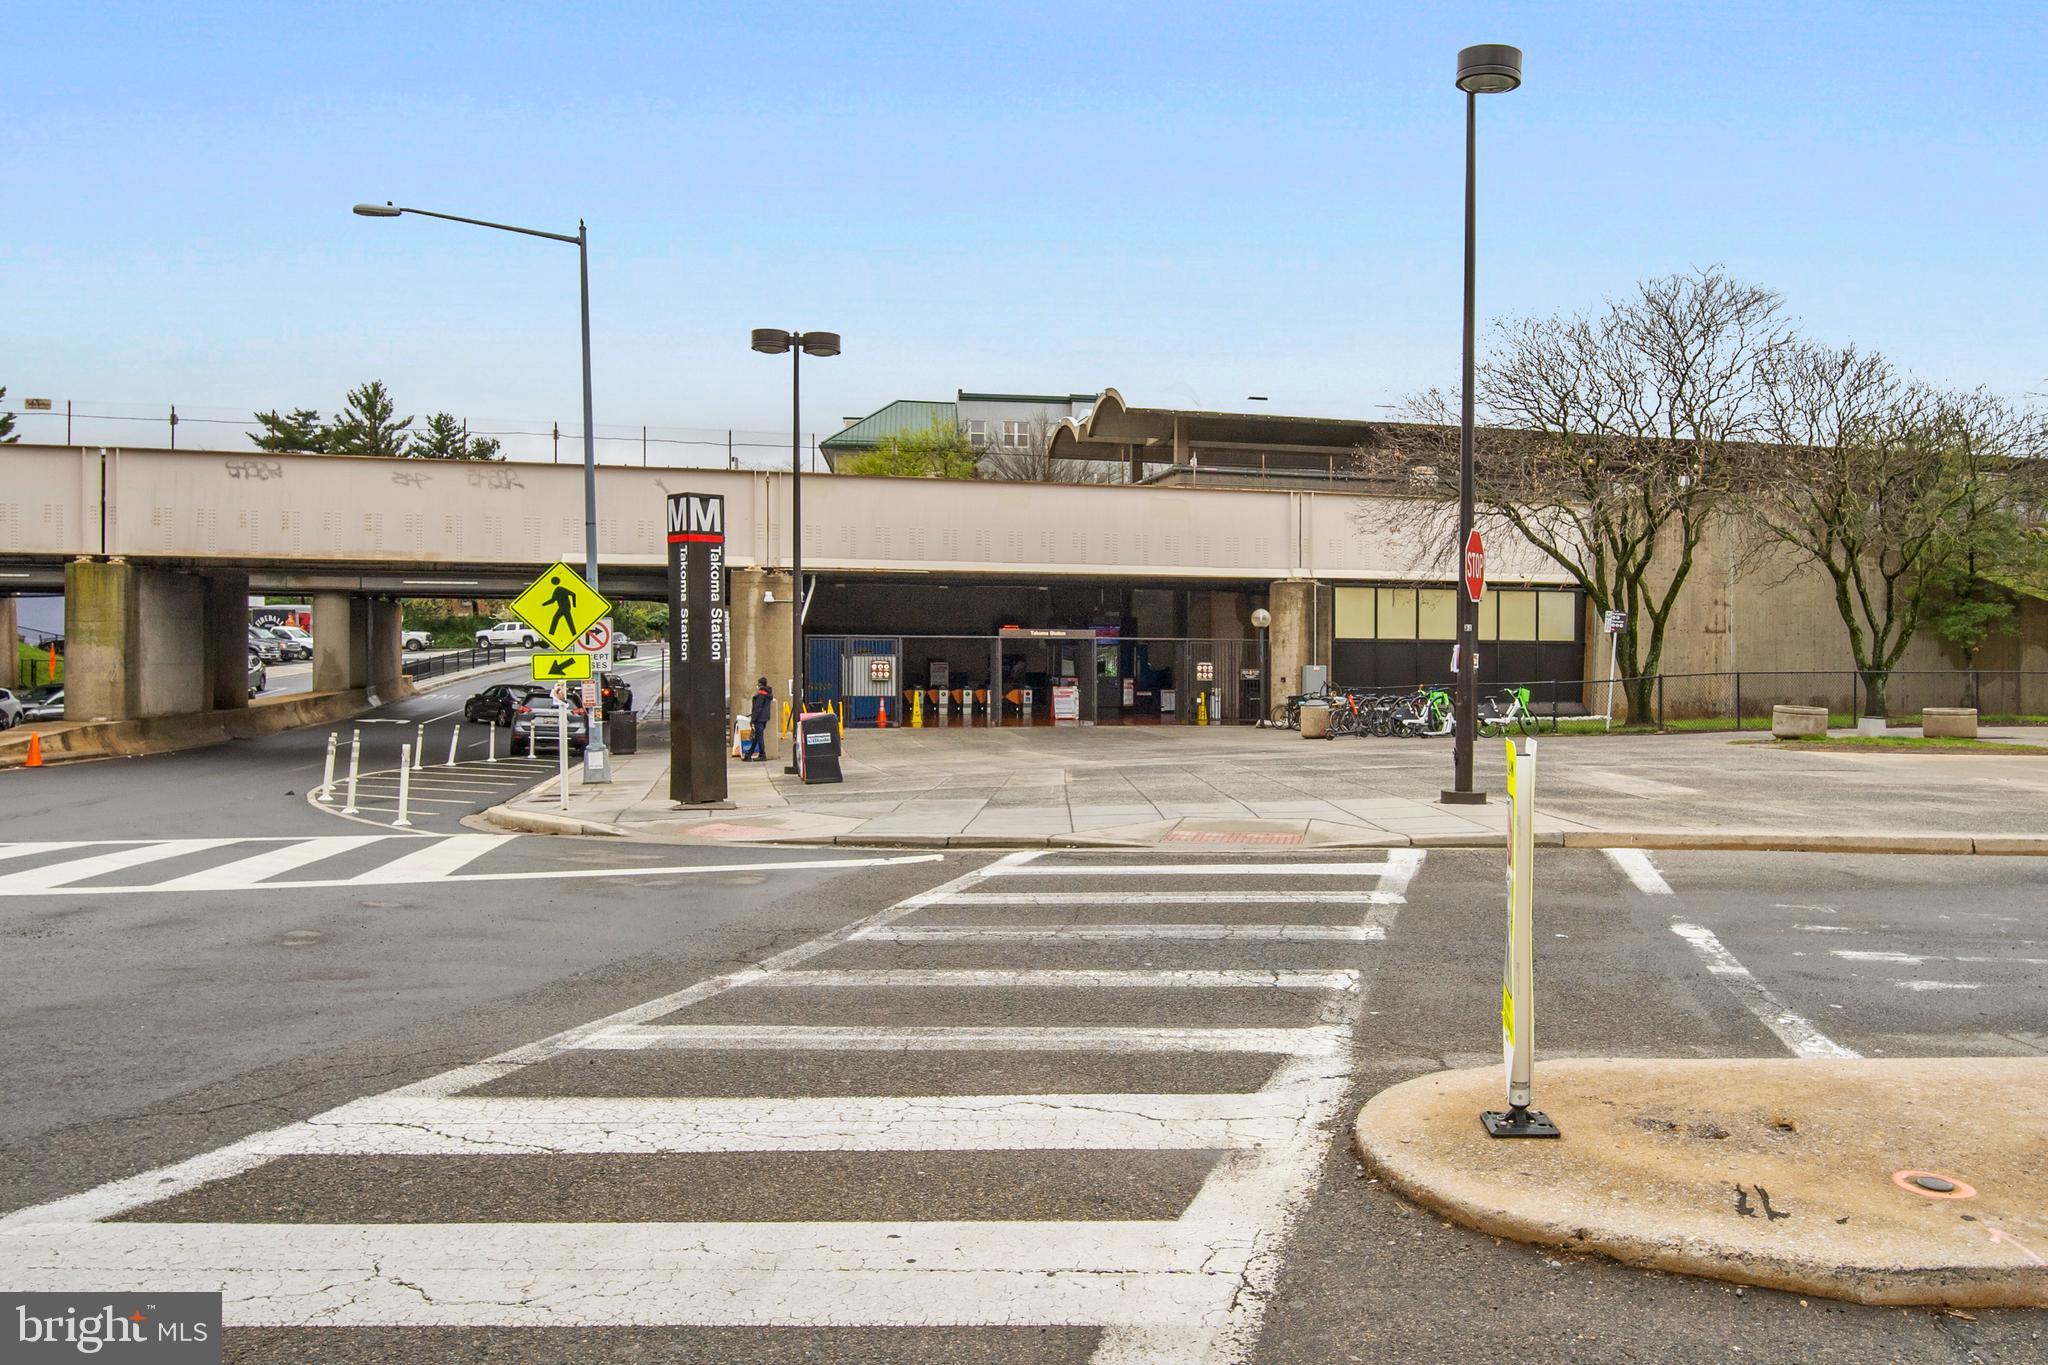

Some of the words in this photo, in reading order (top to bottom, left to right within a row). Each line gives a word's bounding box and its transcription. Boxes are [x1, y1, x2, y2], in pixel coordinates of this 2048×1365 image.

[668, 497, 687, 532] M
[689, 496, 721, 532] M
[679, 545, 688, 602] Takoma
[710, 546, 722, 602] Takoma
[1467, 551, 1484, 579] STOP
[680, 608, 689, 661] Station
[710, 607, 723, 661] Station
[592, 661, 608, 669] SES
[593, 653, 609, 661] EPT
